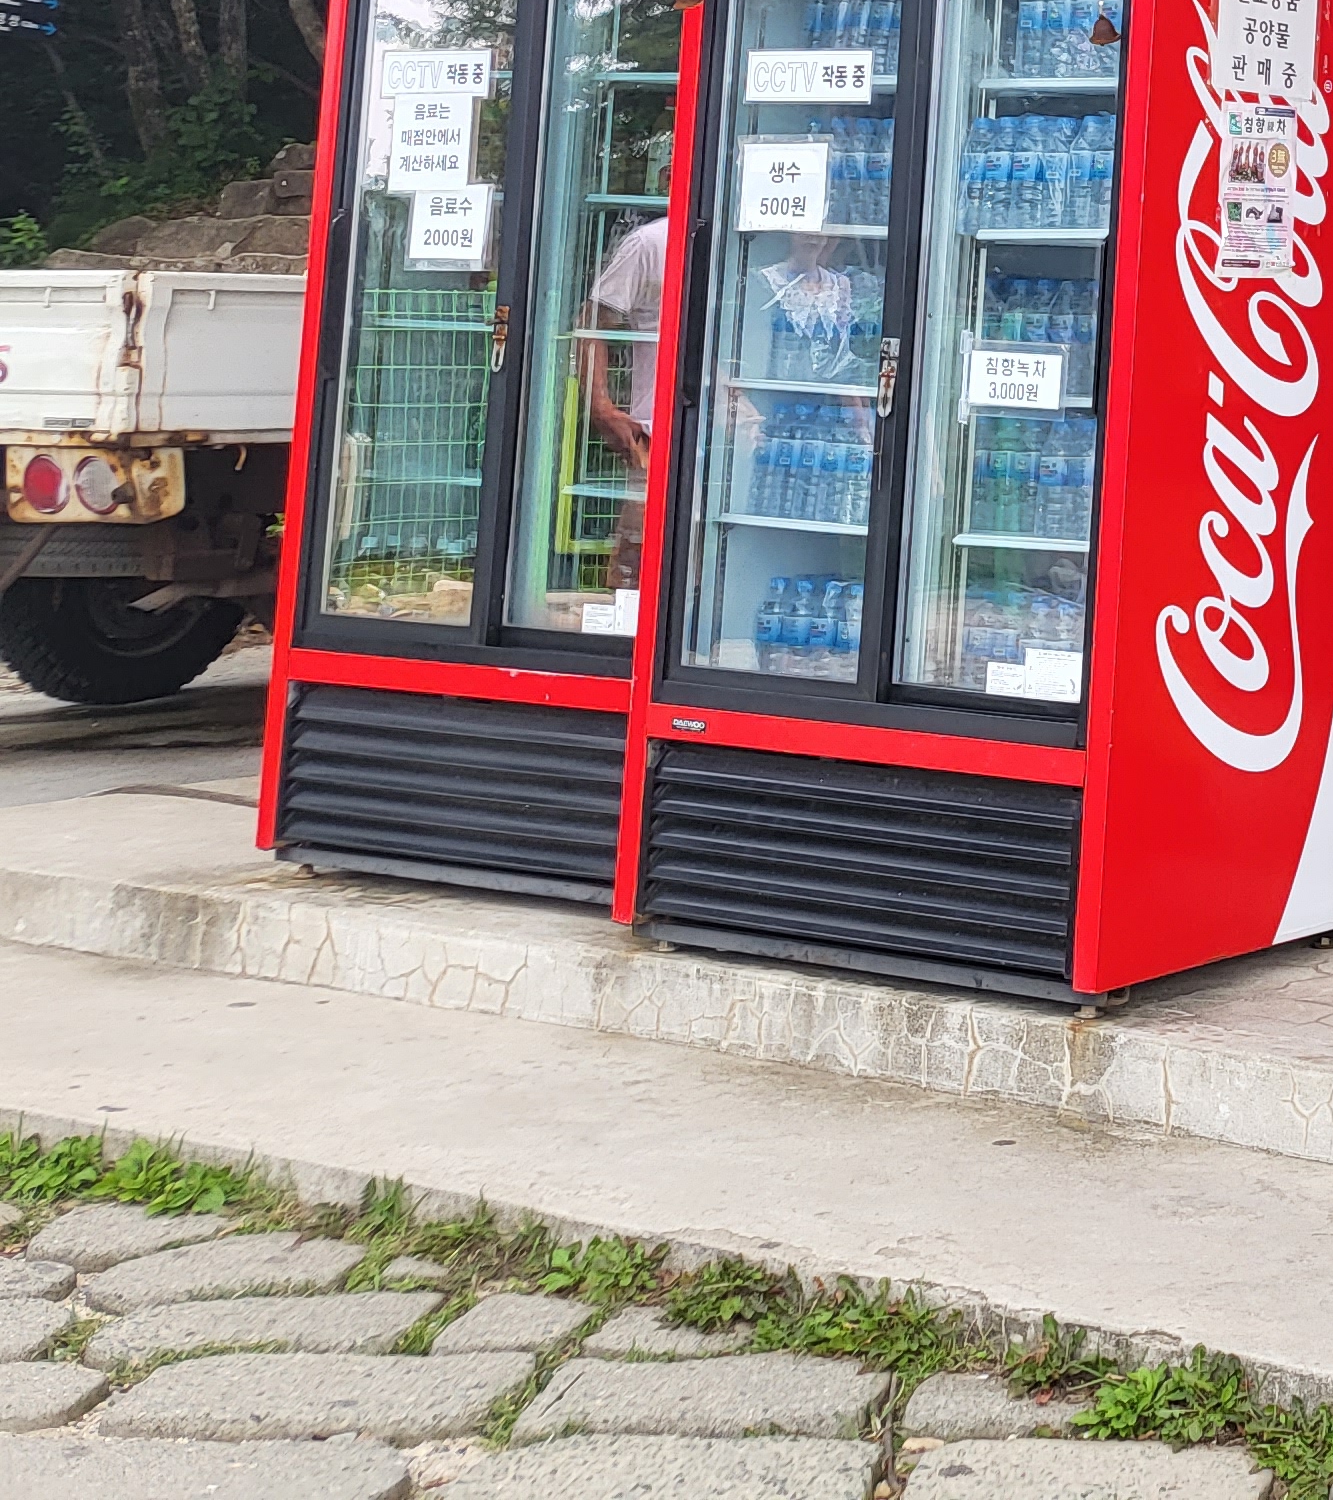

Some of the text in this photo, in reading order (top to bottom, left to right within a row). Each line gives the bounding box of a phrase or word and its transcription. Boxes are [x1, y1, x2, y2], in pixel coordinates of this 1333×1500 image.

[1242, 16, 1291, 50] 공양물
[388, 60, 484, 89] CCTV 작동 중
[753, 61, 866, 93] CCTV 작동 중
[414, 102, 451, 121] 음료는
[400, 127, 462, 147] 매점안에서
[399, 154, 460, 173] 계산하세요
[768, 161, 802, 184] 생수
[429, 196, 473, 217] 음료수
[759, 195, 807, 218] 500원
[423, 228, 474, 249] 2000원
[985, 356, 1047, 379] 침향녹차
[988, 381, 1039, 403] 3,000원
